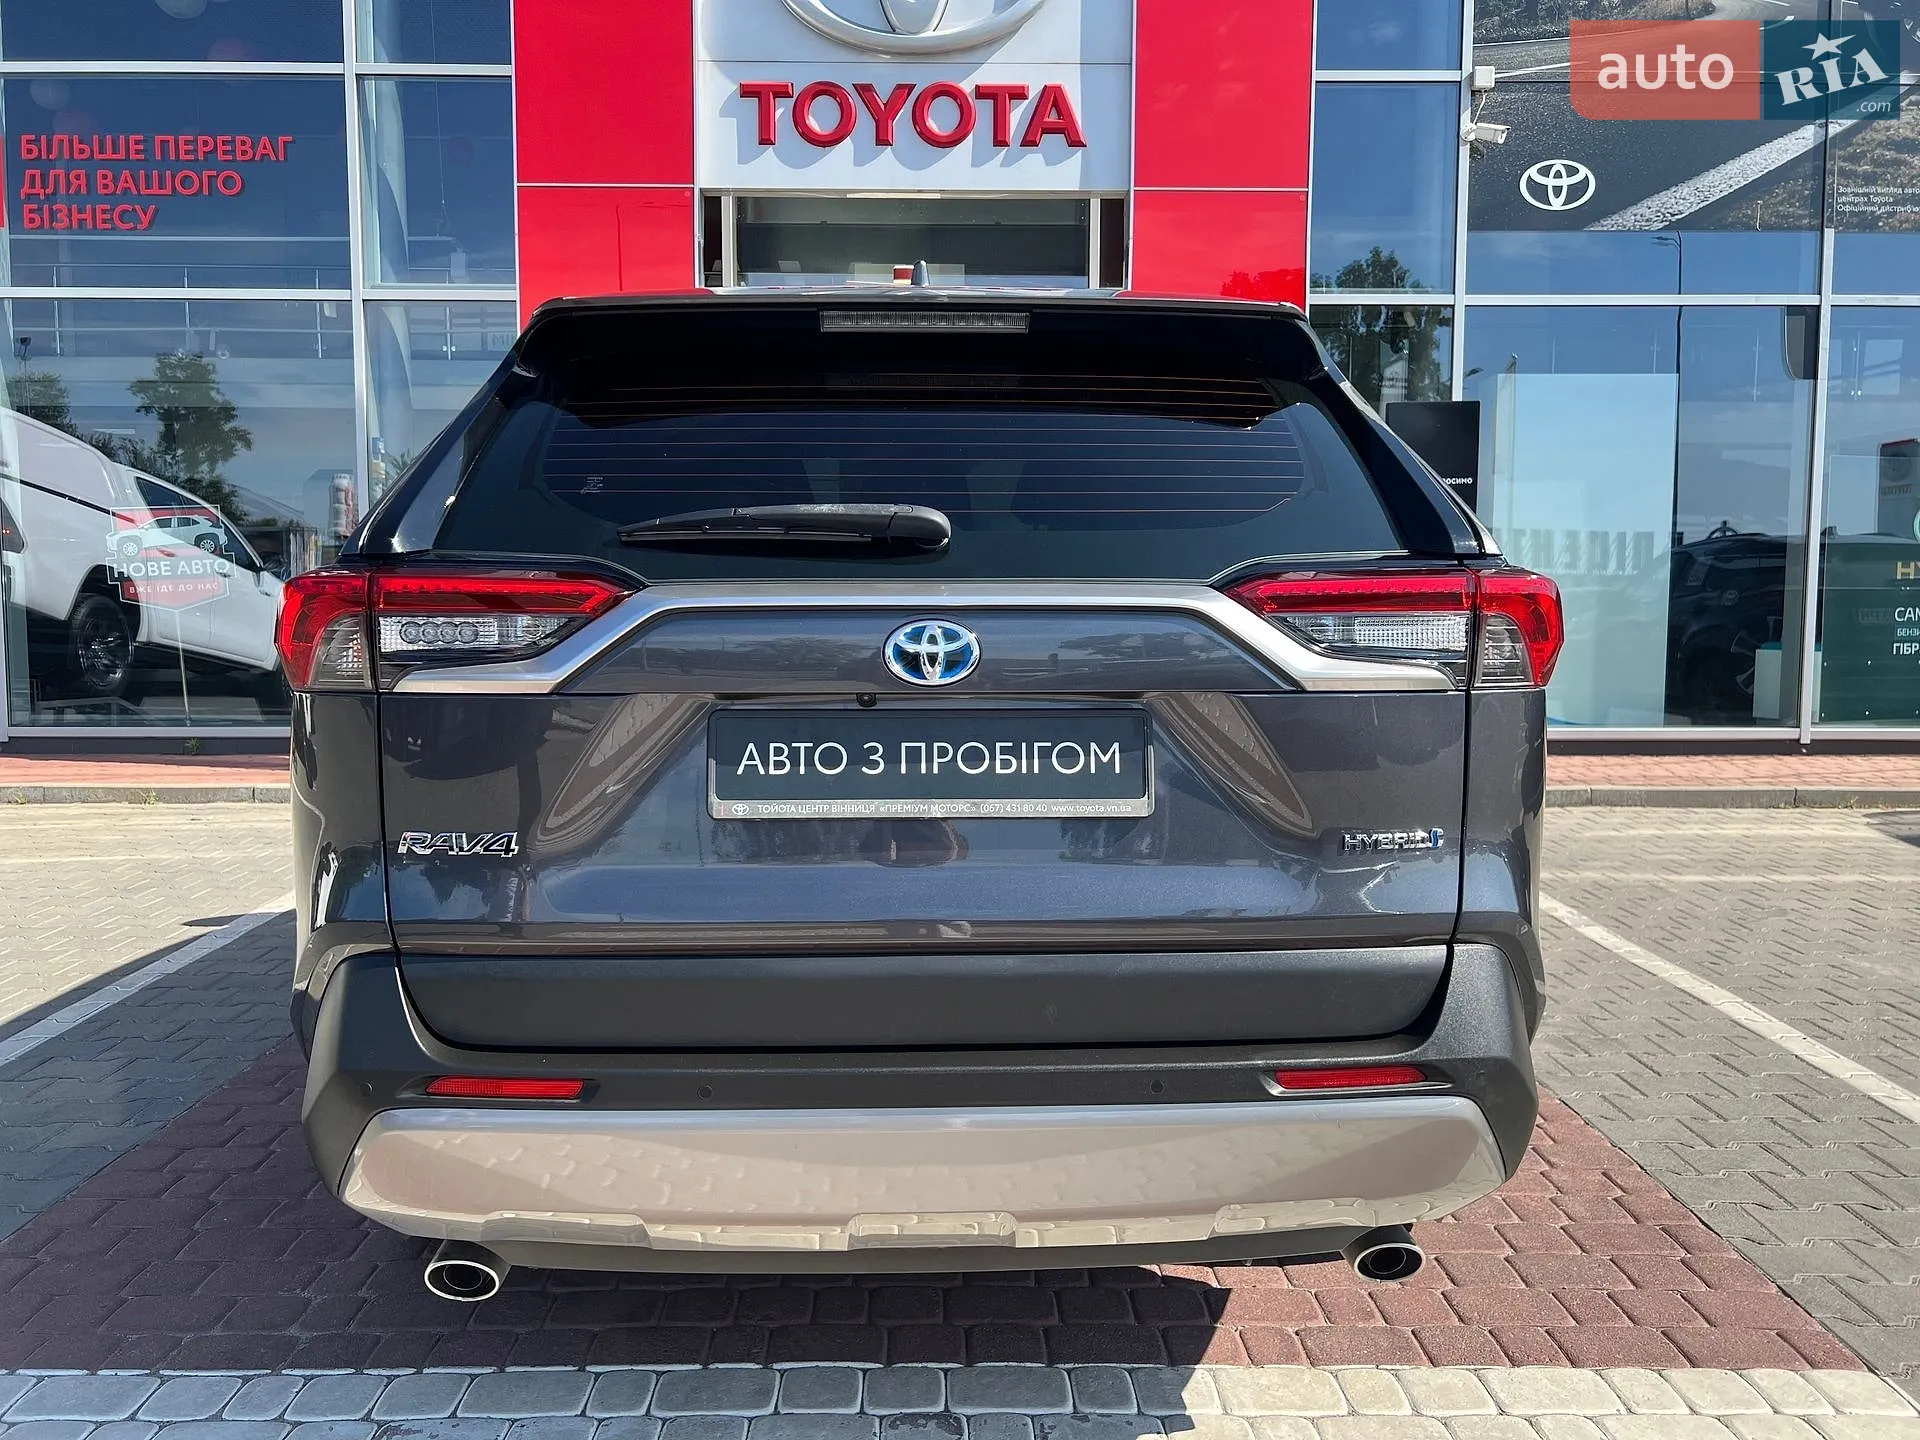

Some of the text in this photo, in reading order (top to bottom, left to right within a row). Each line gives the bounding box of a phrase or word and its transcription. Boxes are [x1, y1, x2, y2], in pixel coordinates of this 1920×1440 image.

[739, 80, 1087, 148] TOYOTA
[20, 134, 294, 161] БІЛЬШЕ ПЕРЕВАГ
[20, 169, 243, 200] ДЛЯ ВАШОГО
[1870, 195, 1893, 204] Toyota
[23, 204, 157, 231] БІЗНЕСУ
[114, 560, 230, 577] НОВЕ АВТО
[129, 582, 218, 594] ВЖЕ ІДЕ ДО НАС
[1893, 643, 1920, 655] ГІБР
[736, 741, 1120, 776] АВТО З ПРОБІГОМ
[758, 803, 1131, 815] ТОЙОТА ЦЕНТР ВІННИЦЯ «ПРЕМІУМ МОТОРС» (067) 431 80 40 www.toyota.vn.ua
[397, 831, 519, 858] RAV4
[1343, 831, 1432, 851] HYBRID
